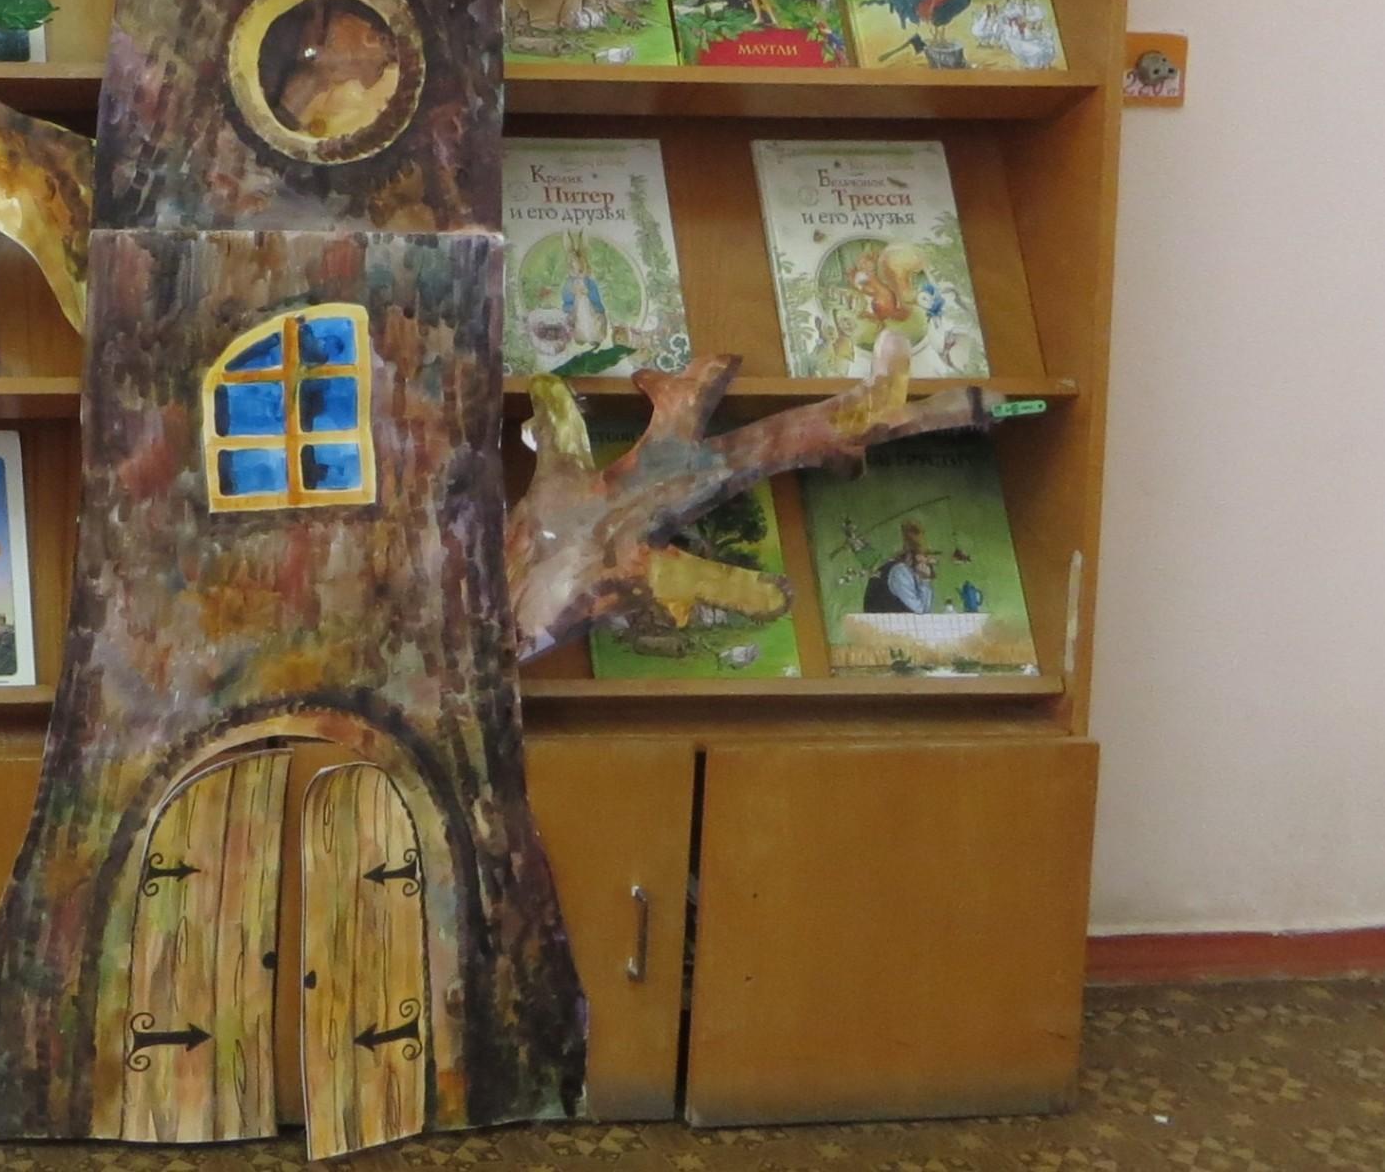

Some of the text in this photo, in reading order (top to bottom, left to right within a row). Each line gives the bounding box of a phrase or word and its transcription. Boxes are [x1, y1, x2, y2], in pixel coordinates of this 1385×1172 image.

[738, 44, 798, 56] МАУГЛИ
[543, 186, 614, 206] Питер
[831, 189, 912, 211] Тресси
[510, 207, 625, 225] и его друзья
[802, 212, 917, 228] и его друзья
